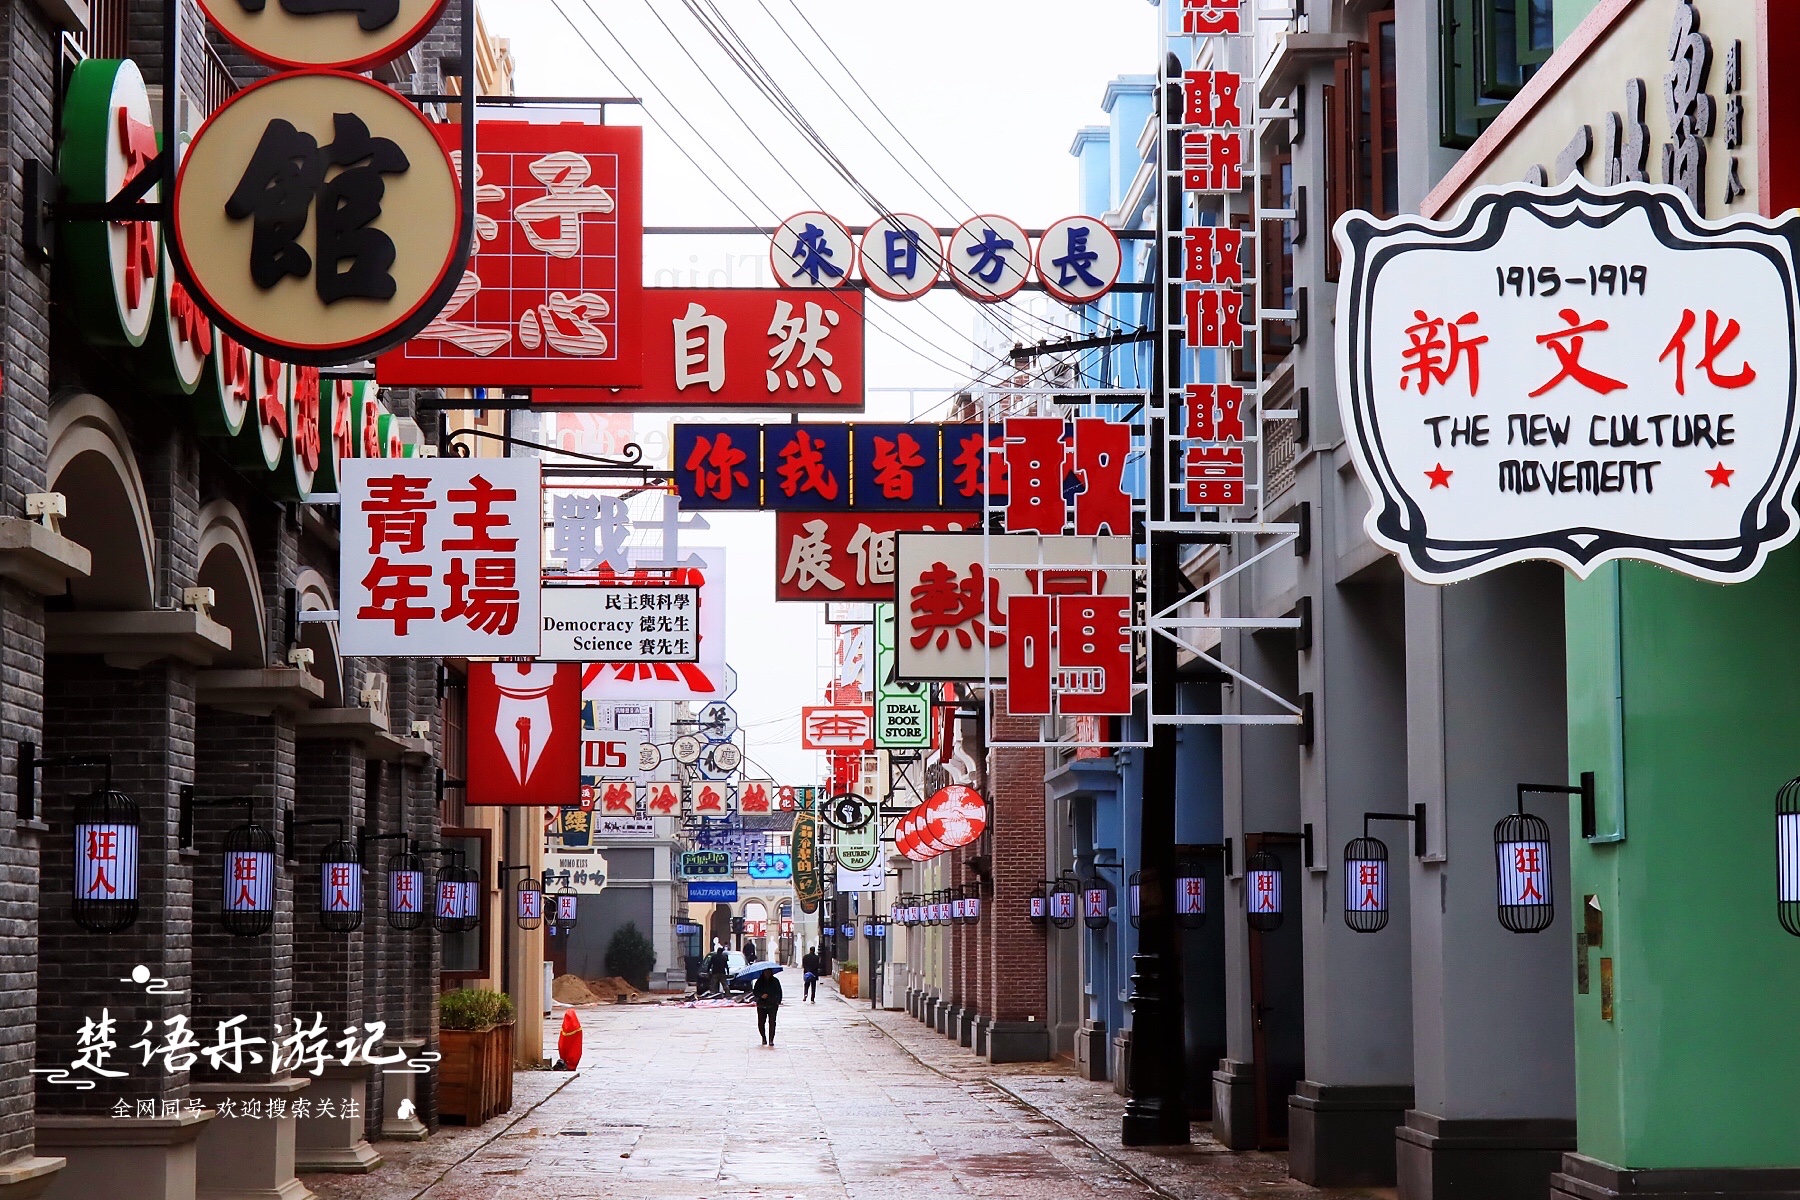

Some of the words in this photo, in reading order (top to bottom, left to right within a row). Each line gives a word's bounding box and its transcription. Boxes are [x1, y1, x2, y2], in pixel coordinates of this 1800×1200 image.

[792, 223, 1104, 286] 來日方長
[1496, 264, 1647, 297] 1915-1919
[673, 300, 841, 393] 自然
[1399, 307, 1758, 398] 新文化
[1423, 414, 1490, 448] THE
[1507, 413, 1571, 448] NEW
[1588, 413, 1735, 449] CULTURE
[685, 430, 1085, 501] 你我皆狂
[1498, 459, 1662, 496] MOVEMENT
[550, 493, 710, 573] 戰士
[605, 594, 690, 610] 民主與科學
[543, 616, 634, 633] Democracy
[639, 616, 690, 632] 德先生
[573, 636, 633, 651] Science
[639, 638, 690, 655] 賽先生
[886, 704, 921, 714] IDEAL
[888, 716, 919, 726] BOOK
[885, 727, 921, 738] STORE
[581, 741, 627, 767] DS
[87, 830, 117, 895] 狂人
[576, 858, 588, 868] KISS
[1514, 847, 1543, 903] 狂人
[233, 857, 257, 907] 狂人
[331, 867, 350, 908] 狂人
[721, 889, 736, 897] YOU
[1257, 874, 1275, 910] 狂人
[1360, 864, 1380, 908] 狂人
